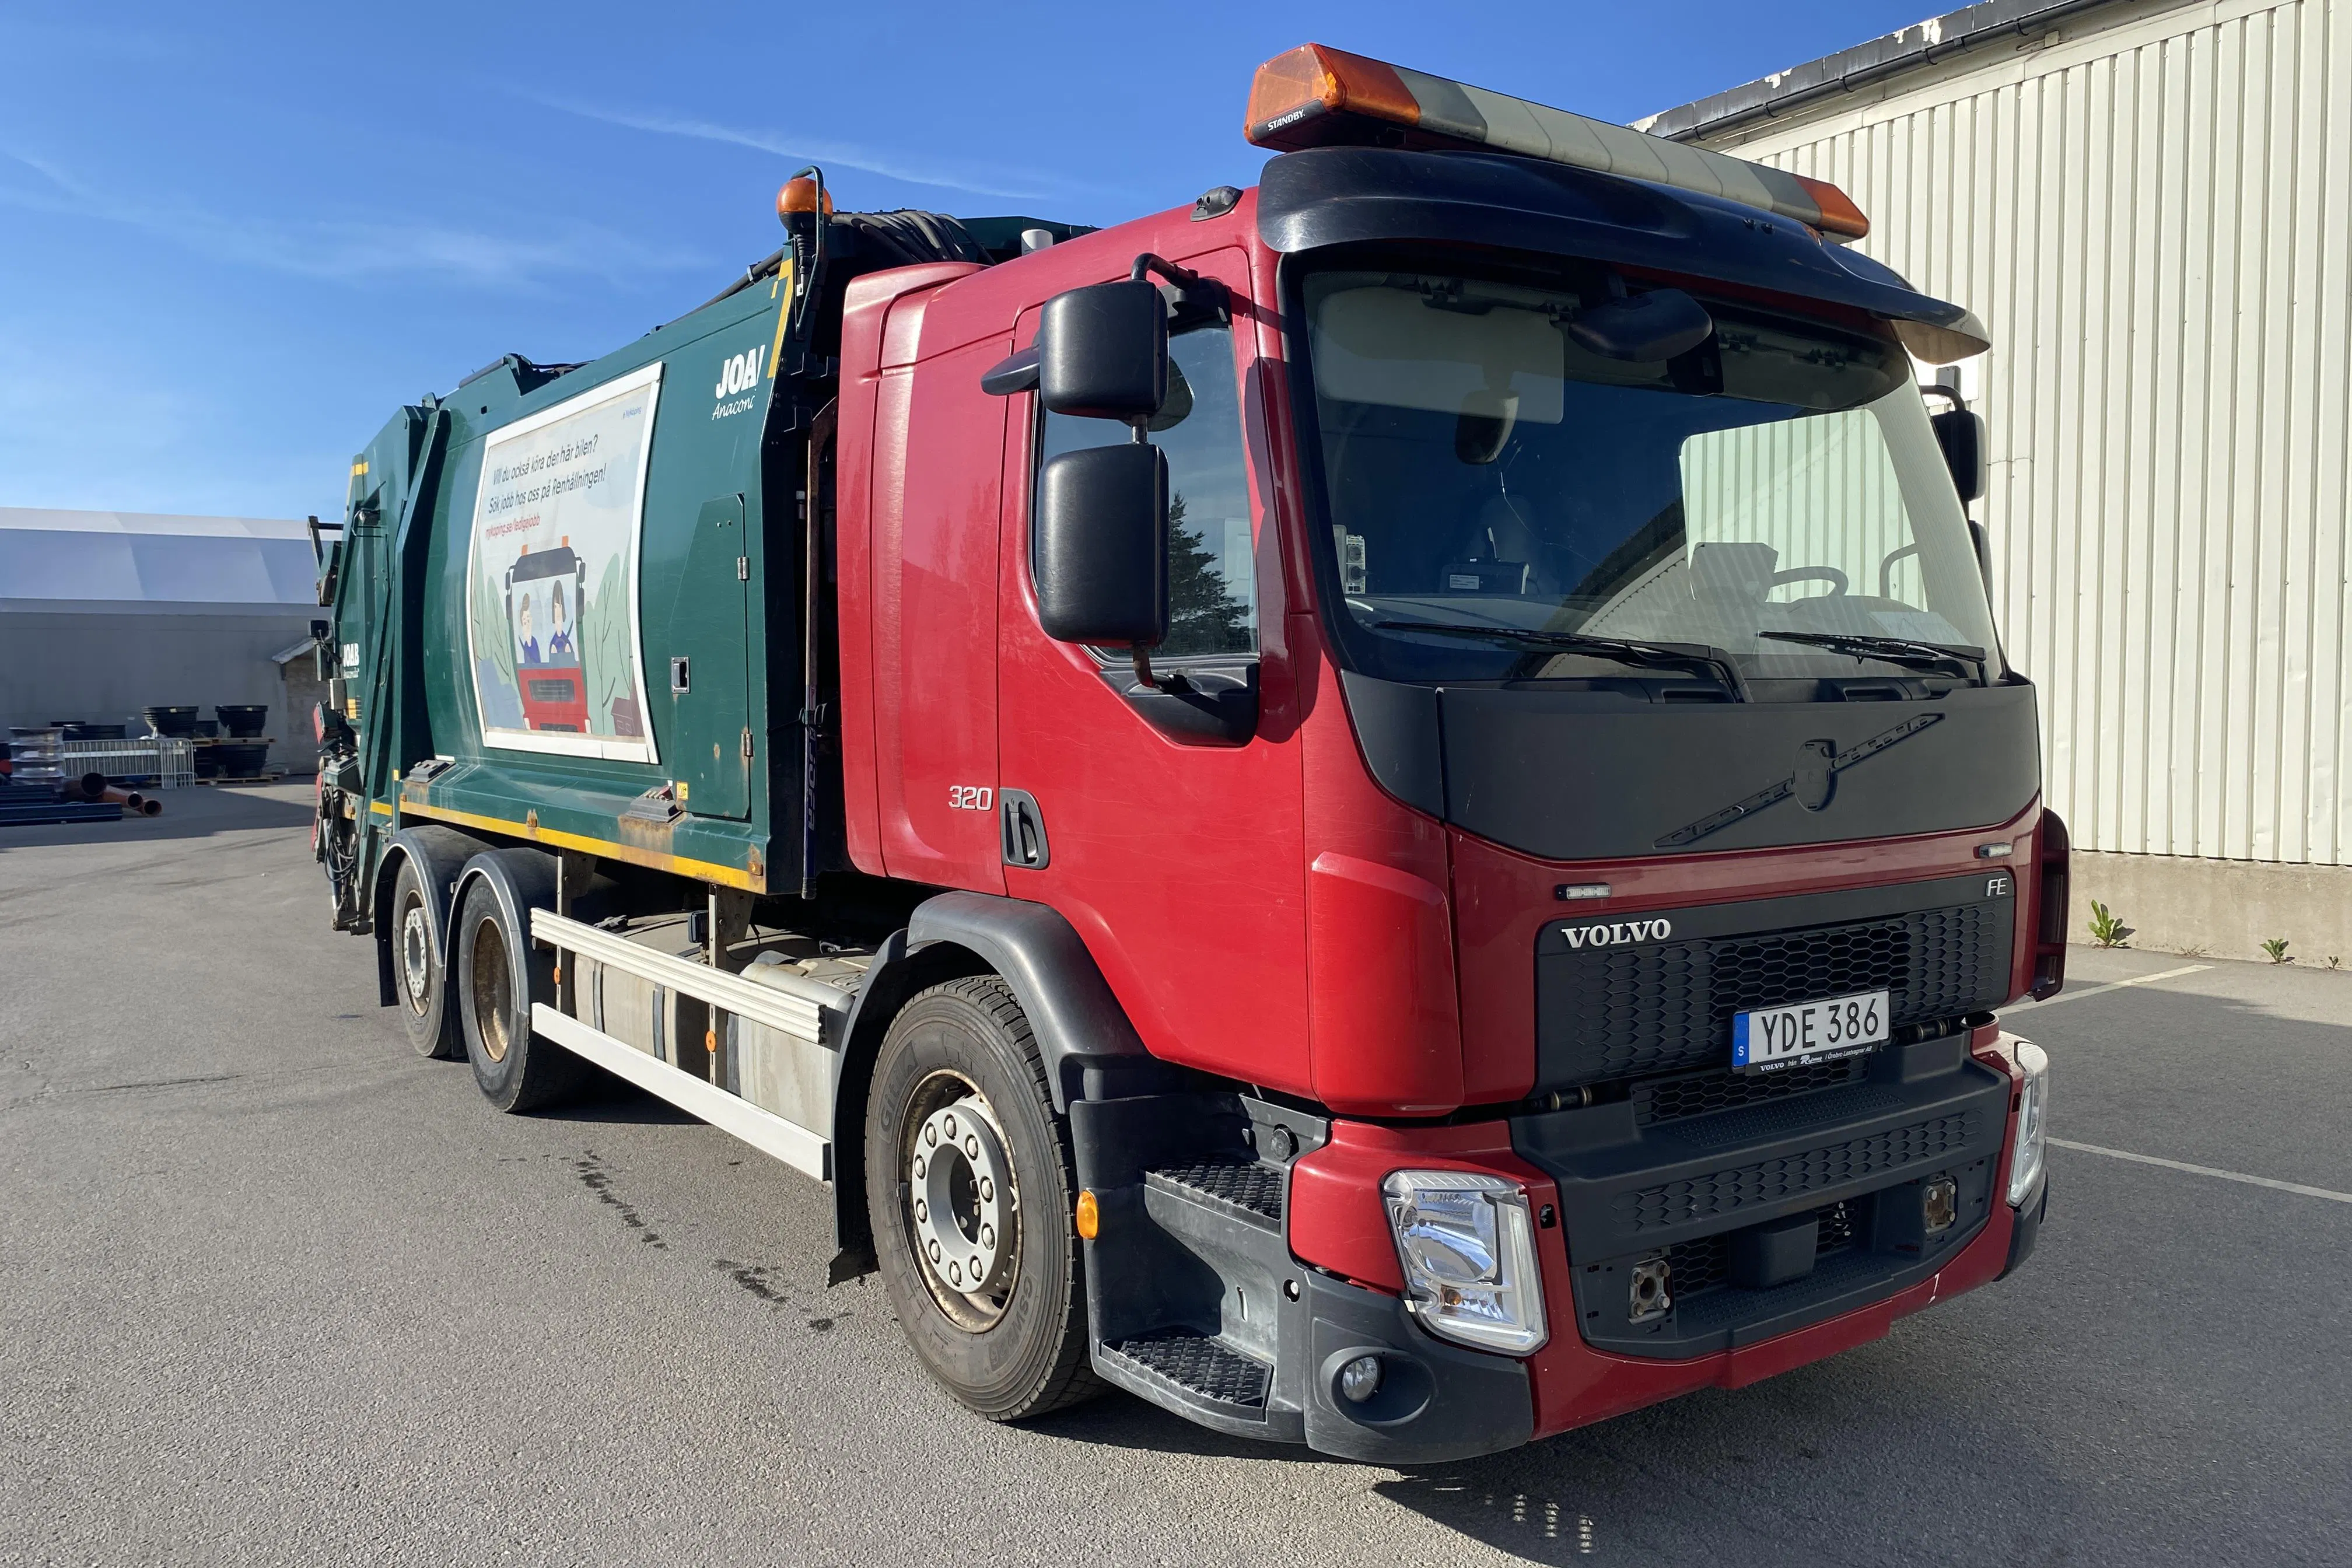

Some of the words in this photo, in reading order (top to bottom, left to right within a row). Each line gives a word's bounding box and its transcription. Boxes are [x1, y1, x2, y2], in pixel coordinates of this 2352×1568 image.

[502, 465, 510, 482] du
[511, 457, 530, 480] också
[530, 454, 545, 474] köra
[547, 450, 559, 468] den
[560, 444, 574, 463] här
[575, 434, 598, 459] bilen?
[489, 496, 501, 513] Sök
[499, 491, 514, 514] jobb
[515, 490, 526, 506] hos
[527, 488, 540, 502] oss
[541, 479, 551, 503] på
[552, 463, 607, 496] Renhållningen!
[949, 785, 993, 811] 320
[1987, 877, 2007, 897] FE
[1561, 919, 1671, 949] VOLVO
[1761, 1008, 1816, 1055] YDE
[1828, 998, 1878, 1043] 386
[1738, 1045, 1744, 1057] S
[1760, 1062, 1784, 1071] VOLVO
